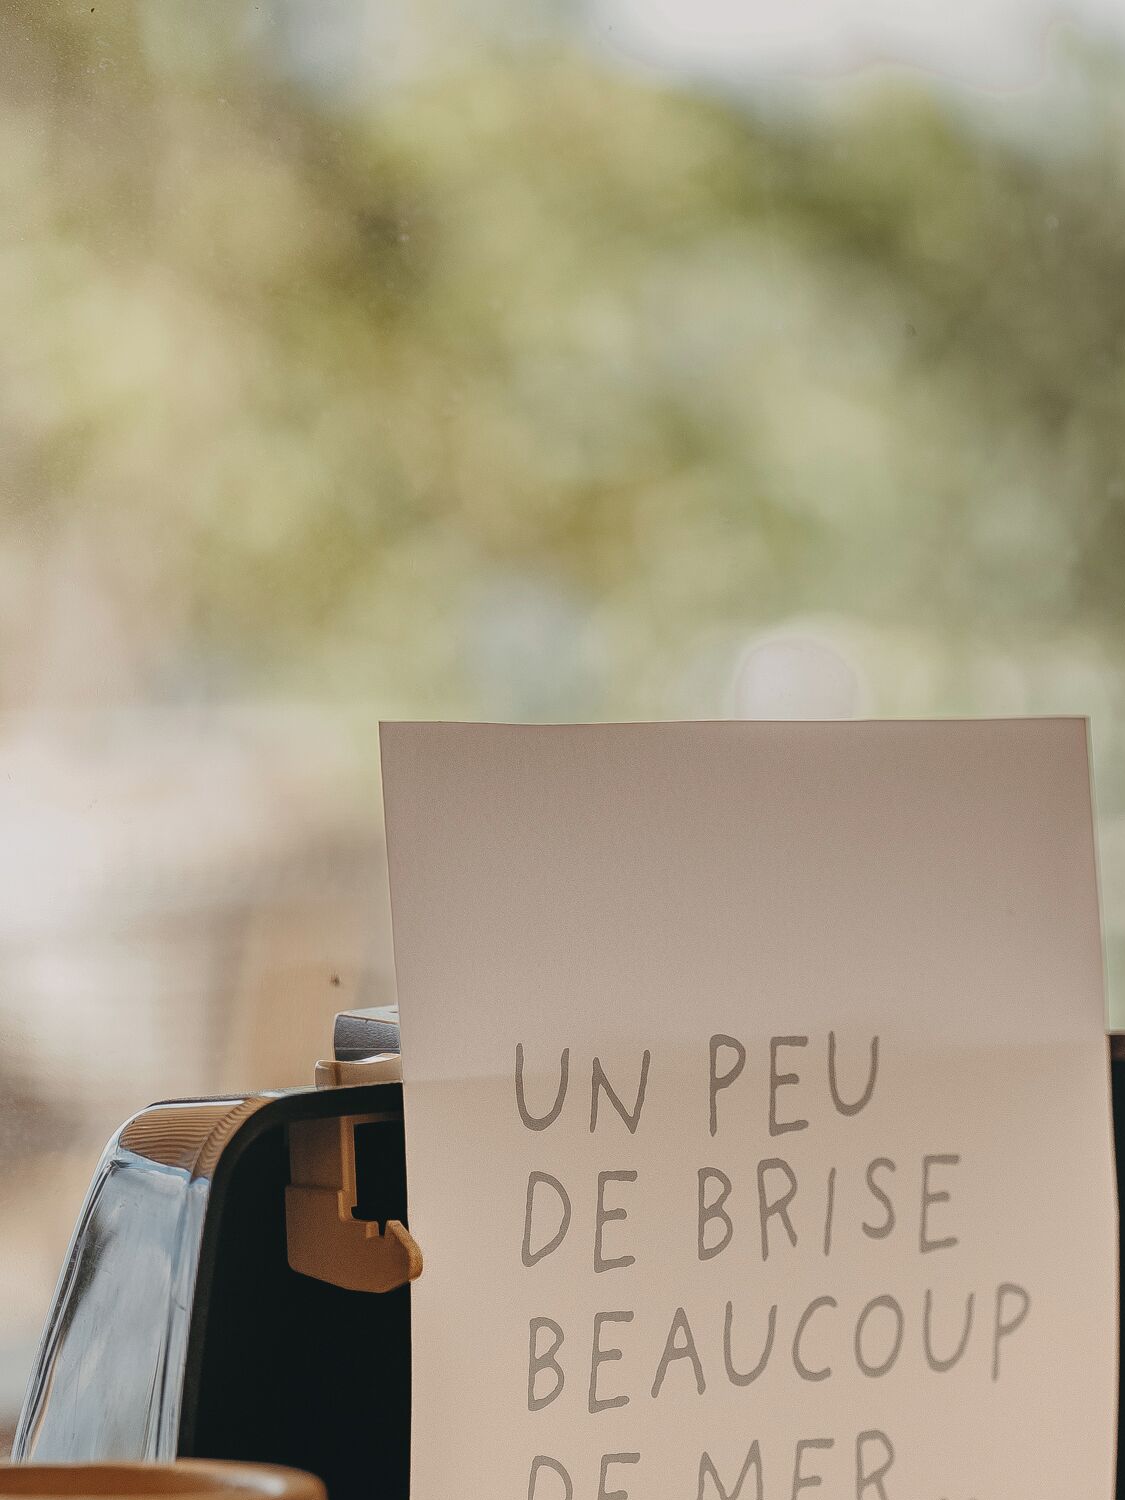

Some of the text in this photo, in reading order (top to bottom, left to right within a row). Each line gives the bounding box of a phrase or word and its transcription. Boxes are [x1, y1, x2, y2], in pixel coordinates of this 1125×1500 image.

[515, 1030, 880, 1138] UN PEU
[521, 1153, 961, 1273] DE BRISE
[526, 1281, 1031, 1415] BEAUCOUP
